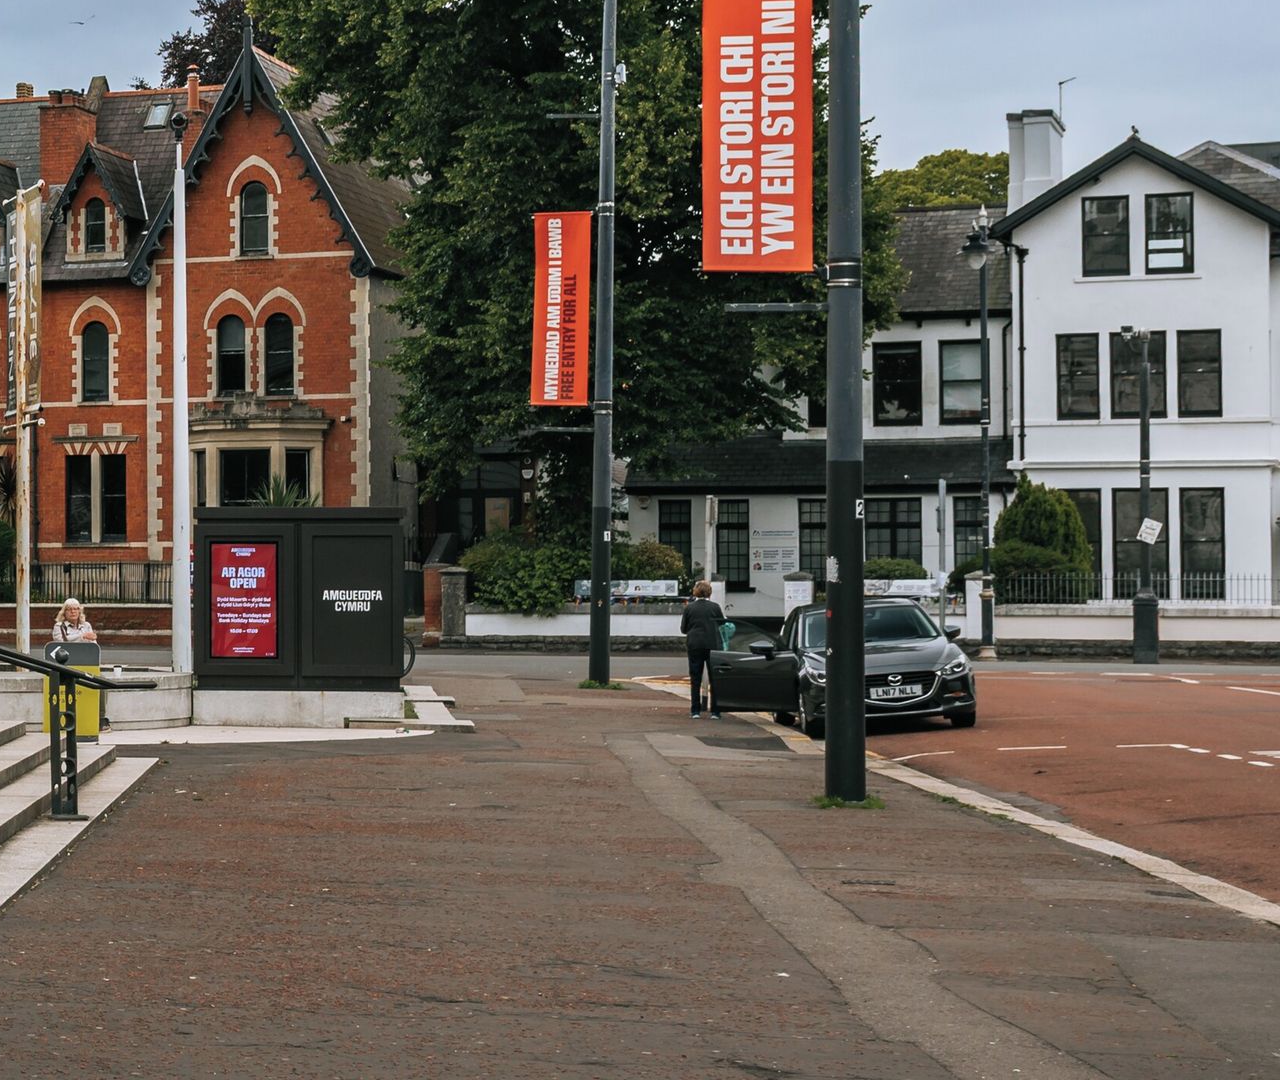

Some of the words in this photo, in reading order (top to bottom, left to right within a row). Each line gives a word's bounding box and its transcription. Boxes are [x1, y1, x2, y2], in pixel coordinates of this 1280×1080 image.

[720, 35, 754, 84] CHI
[761, 42, 795, 137] STORI
[720, 91, 754, 184] STORI
[761, 144, 795, 195] EIN
[548, 218, 562, 258] BAWB
[720, 191, 753, 255] EICH
[761, 202, 794, 256] YW
[564, 273, 576, 297] ALL
[546, 306, 560, 328] AM
[563, 299, 576, 324] FOR
[561, 326, 576, 367] ENTRY
[543, 330, 560, 400] MYNEDIAD
[560, 370, 575, 400] FREE
[857, 501, 864, 516] 2
[221, 567, 236, 578] AR
[237, 567, 265, 578] AGOR
[230, 577, 257, 588] OPEN
[322, 589, 383, 601] AMGUEDDFA
[334, 601, 371, 612] CYMRU
[875, 687, 896, 697] LN17
[898, 686, 916, 696] NLL
